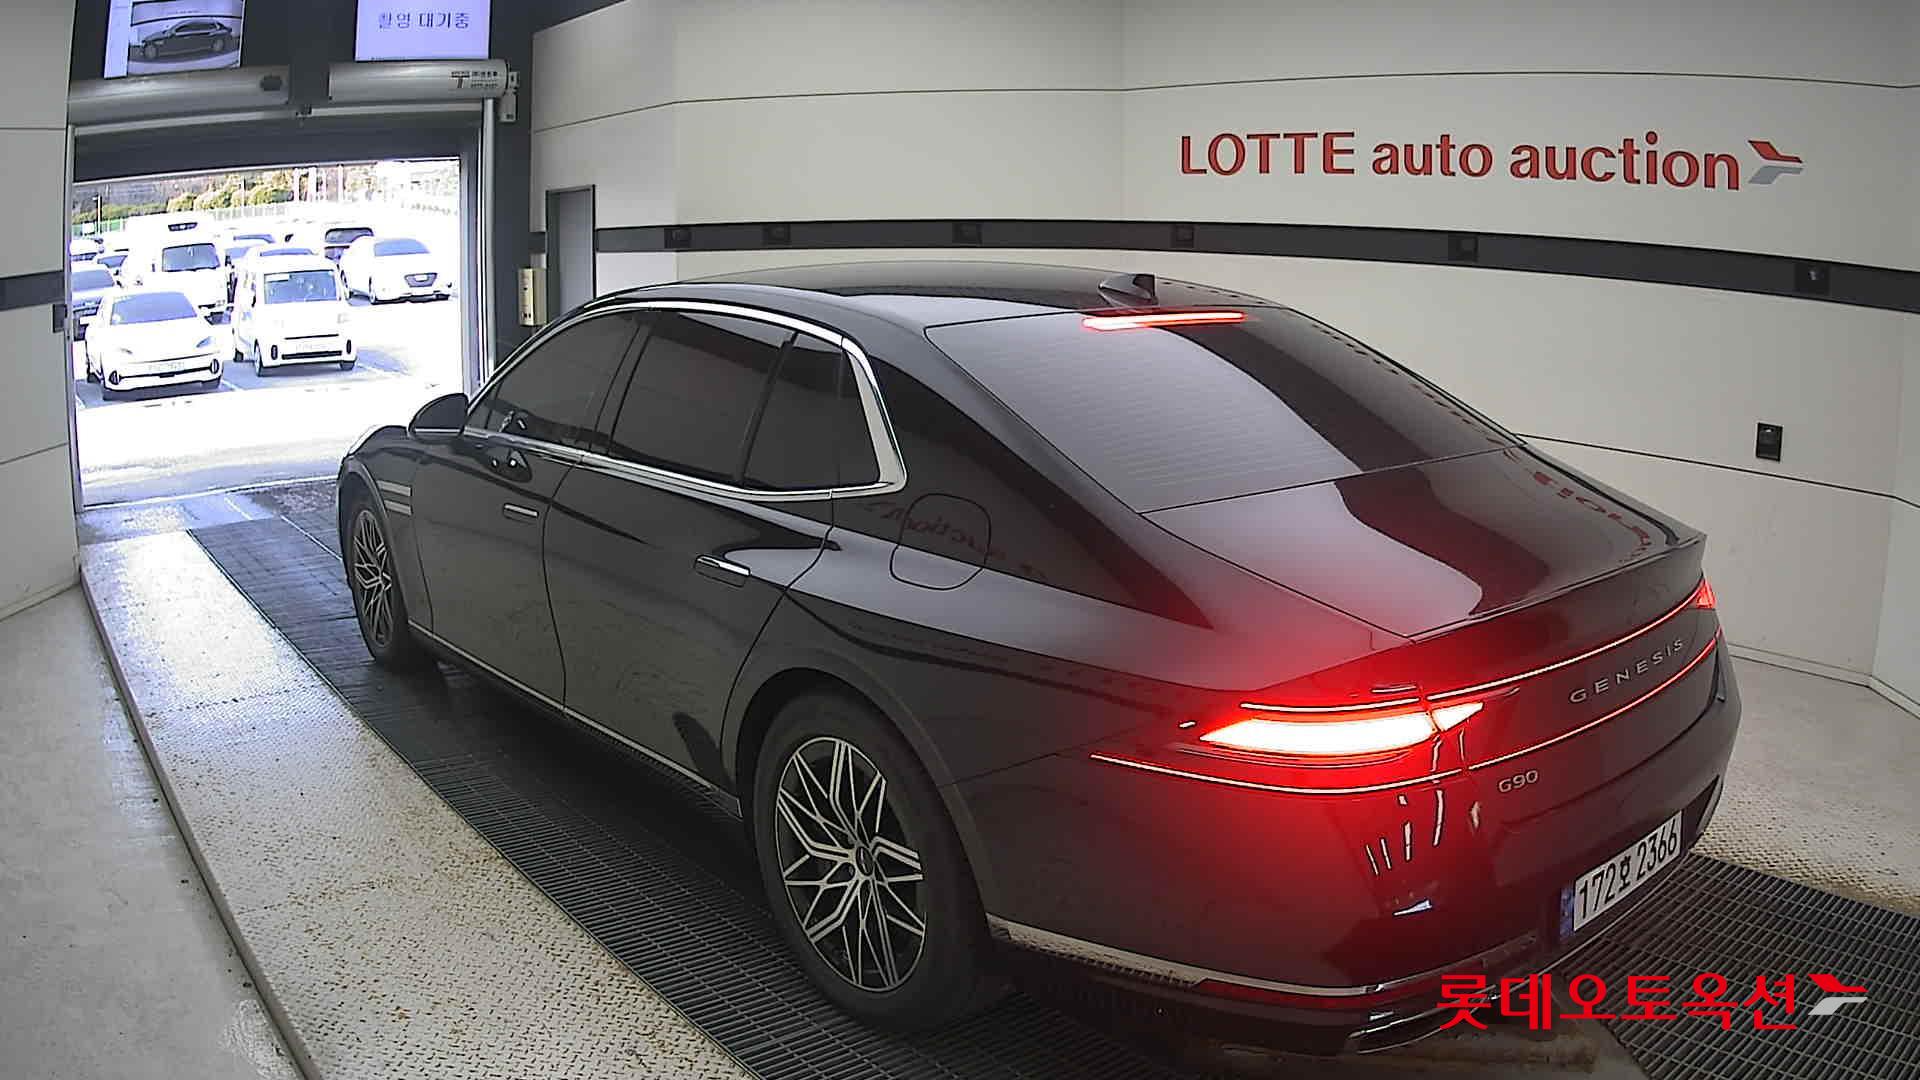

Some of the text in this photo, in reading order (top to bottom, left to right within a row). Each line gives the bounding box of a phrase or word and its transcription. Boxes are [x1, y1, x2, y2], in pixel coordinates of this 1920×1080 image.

[418, 12, 469, 29] 대기중
[1181, 131, 1740, 190] LOTTE auto auction
[1569, 638, 1684, 703] GENESIS
[1498, 769, 1540, 793] G90
[1579, 819, 1677, 919] 172호 2366
